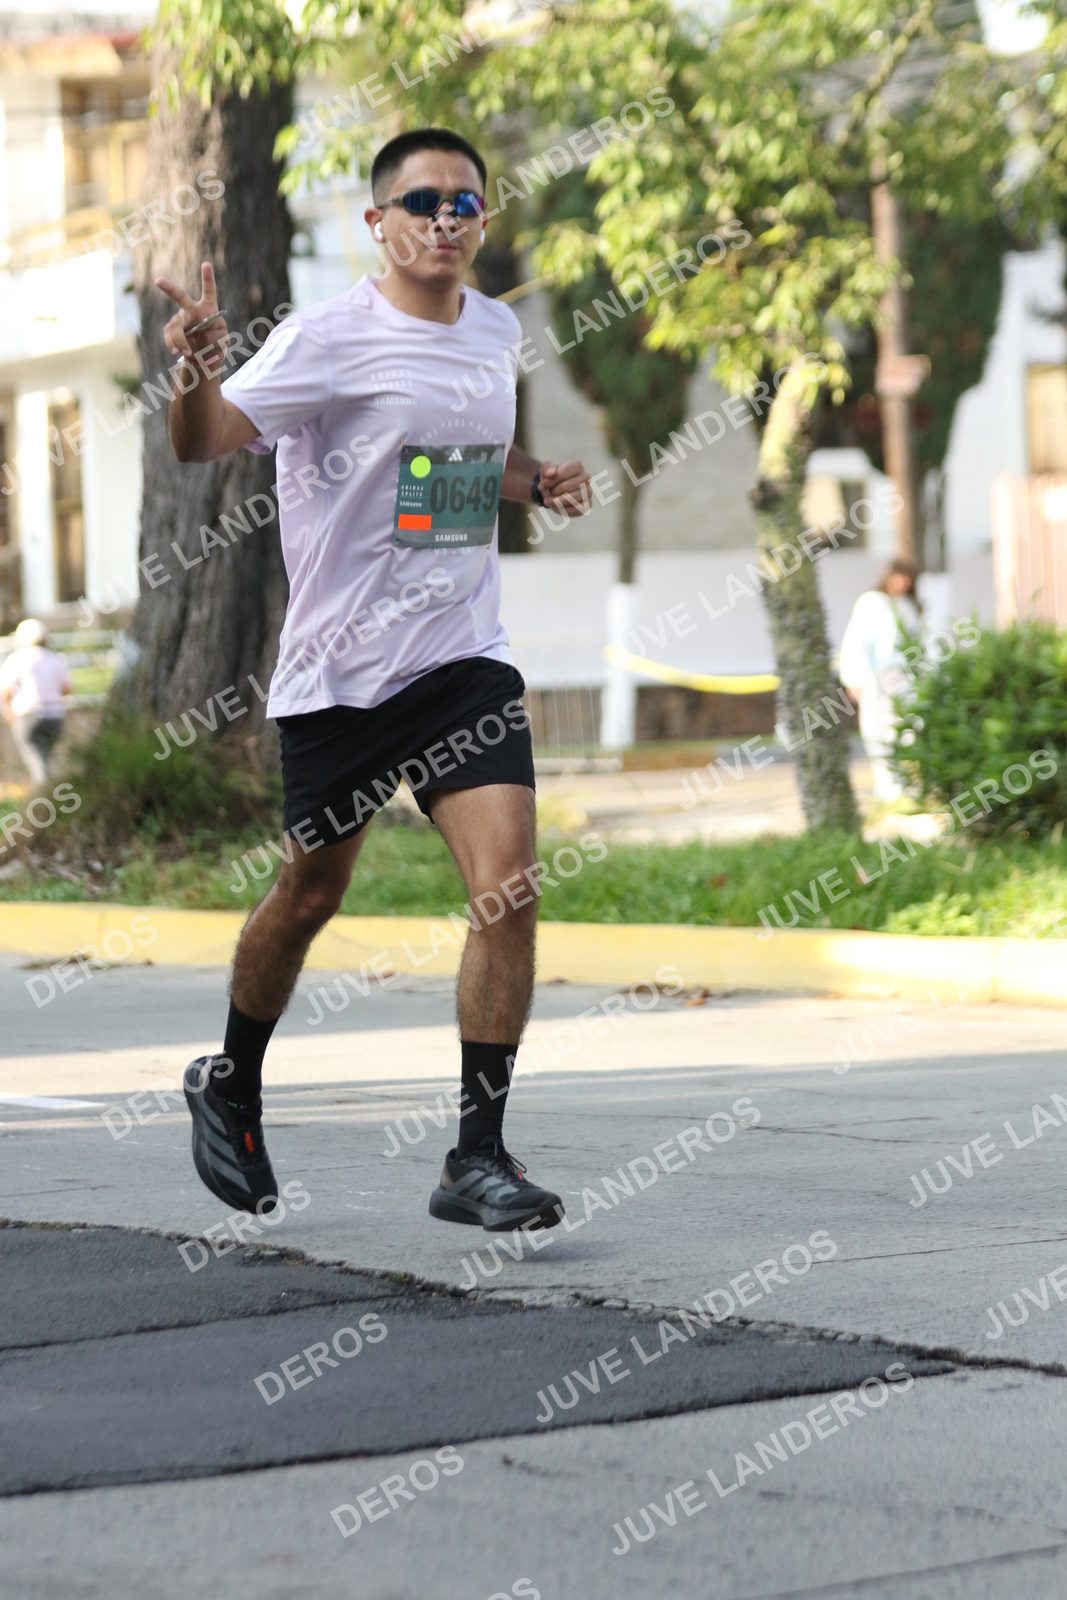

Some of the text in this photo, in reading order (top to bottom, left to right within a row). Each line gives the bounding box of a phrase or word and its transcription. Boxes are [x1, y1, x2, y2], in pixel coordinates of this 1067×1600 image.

[374, 397, 418, 406] SAMSUNG
[430, 475, 498, 514] 0649
[434, 533, 468, 543] SAMSUNG
